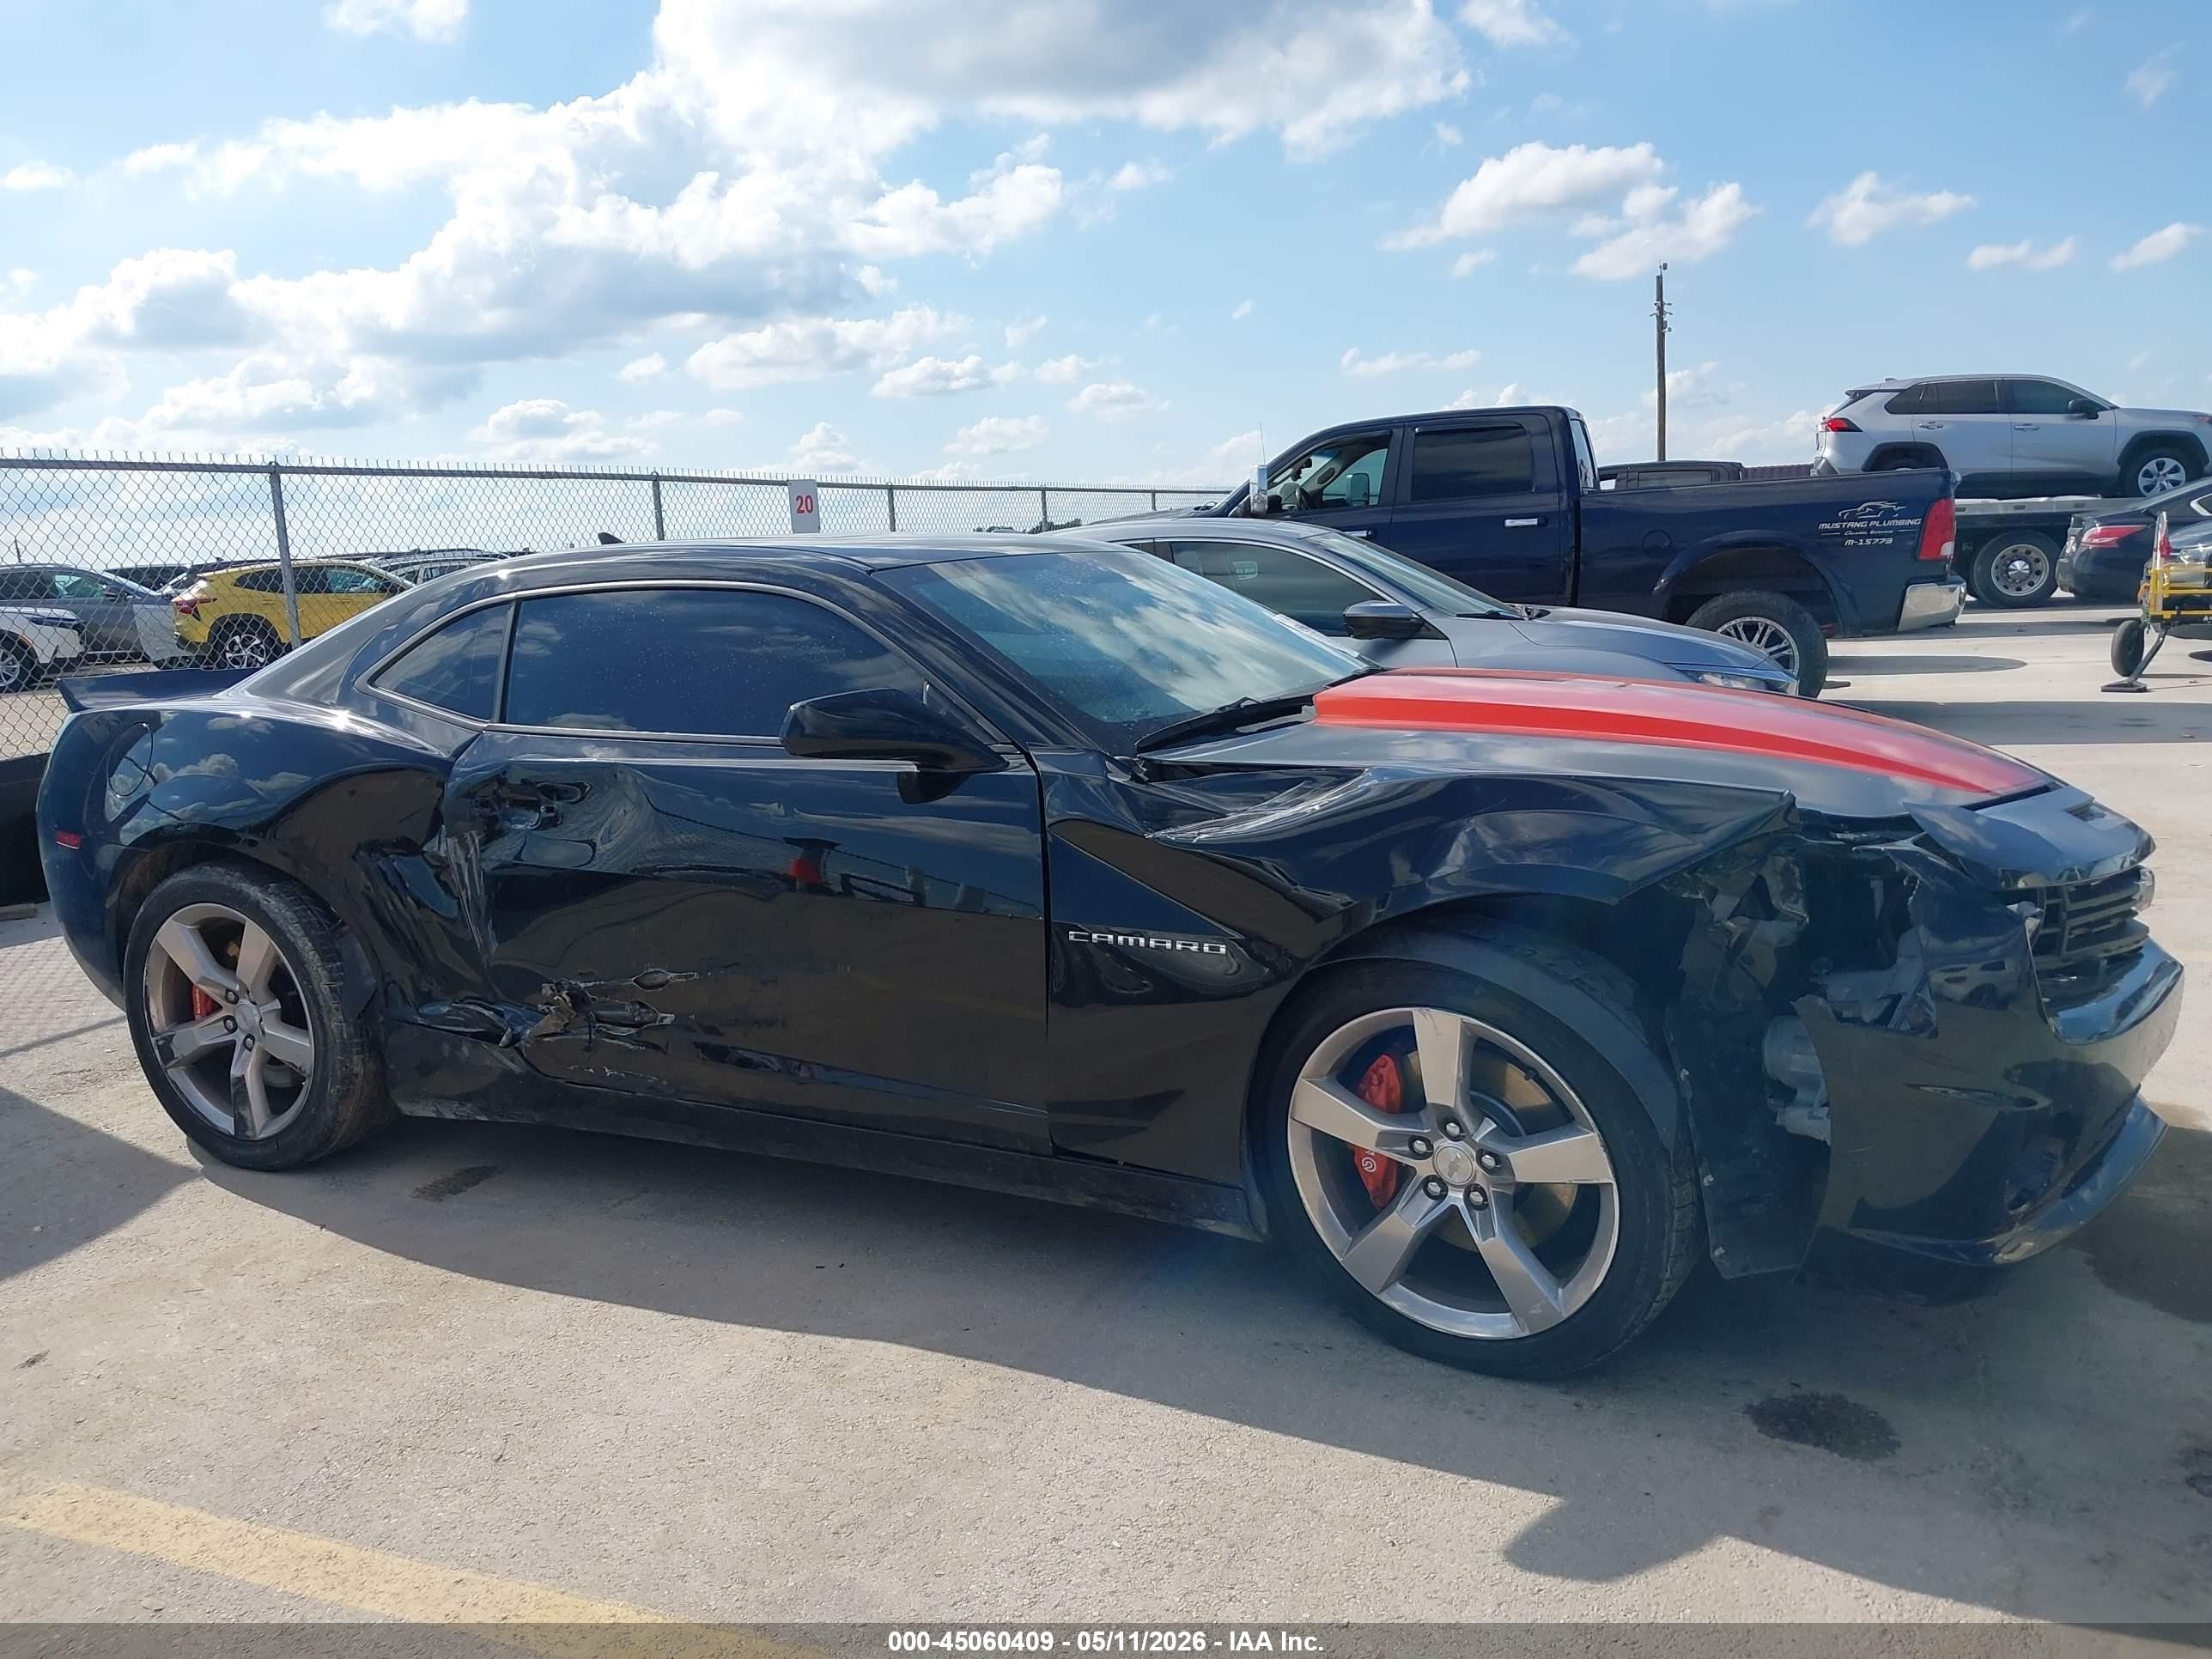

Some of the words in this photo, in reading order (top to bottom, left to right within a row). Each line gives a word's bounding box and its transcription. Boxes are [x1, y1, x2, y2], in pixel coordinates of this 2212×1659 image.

[795, 495, 814, 514] 20
[1818, 520, 1869, 530] MUSTANG
[1869, 518, 1923, 527] PLUMBING
[1068, 931, 1227, 955] CAMARO
